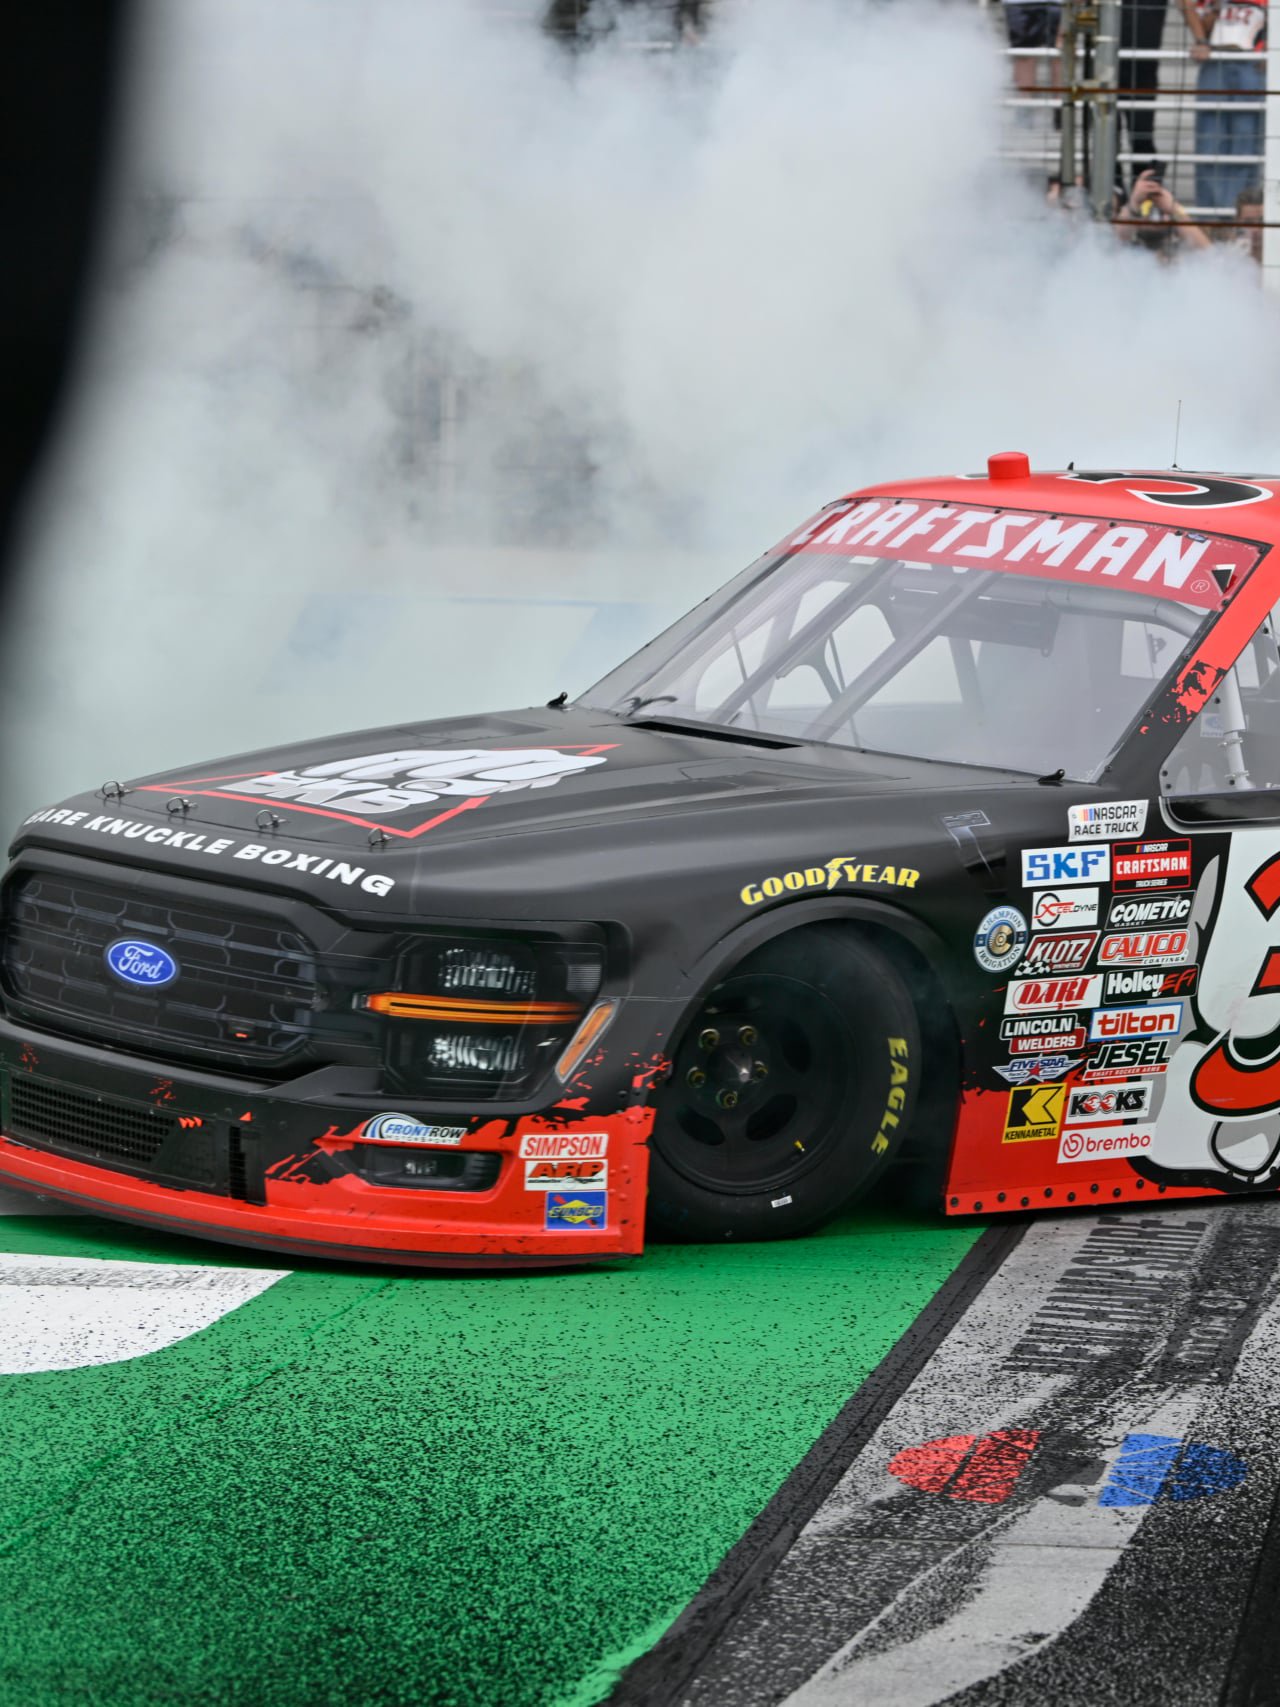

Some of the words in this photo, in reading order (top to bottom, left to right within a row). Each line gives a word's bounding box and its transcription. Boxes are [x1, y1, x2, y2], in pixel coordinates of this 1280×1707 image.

[789, 501, 1211, 589] CRAFTSMAN
[1093, 805, 1137, 821] NASCAR
[1074, 824, 1101, 836] RACE
[1104, 822, 1139, 834] TRUCK
[23, 808, 89, 826] BARE
[83, 815, 235, 854] KNUCKLE
[234, 842, 395, 897] BOXING
[1026, 850, 1106, 881] SKF
[1116, 856, 1187, 875] CRAFTSMAN
[983, 910, 1022, 931] CHAMPION
[1110, 899, 1191, 923] COMETIC
[1114, 920, 1145, 928] GASKET
[1029, 939, 1092, 963] KLOTZ
[1101, 931, 1187, 960] CALICO
[118, 945, 164, 979] Ford
[978, 946, 1021, 969] IRRIGATION
[1143, 956, 1185, 964] COATINGS
[1018, 975, 1096, 1005] DART
[1107, 971, 1165, 997] Holley
[1004, 1017, 1072, 1037] LINCOLN
[1098, 1011, 1175, 1036] tilton
[1018, 1034, 1076, 1052] WELDERS
[1088, 1040, 1168, 1069] JESEL
[1009, 1060, 1036, 1072] FIVE
[1092, 1070, 1116, 1078] SHAFT
[1116, 1068, 1141, 1076] ROCKER
[1142, 1066, 1160, 1074] ARMS
[871, 1038, 909, 1155] EAGLE
[1004, 1127, 1056, 1140] KENNAMETAL
[1086, 1133, 1150, 1152] brembo
[524, 1136, 601, 1156] SIMPSON
[528, 1162, 604, 1178] ARP
[549, 1206, 603, 1218] SUNOCO
